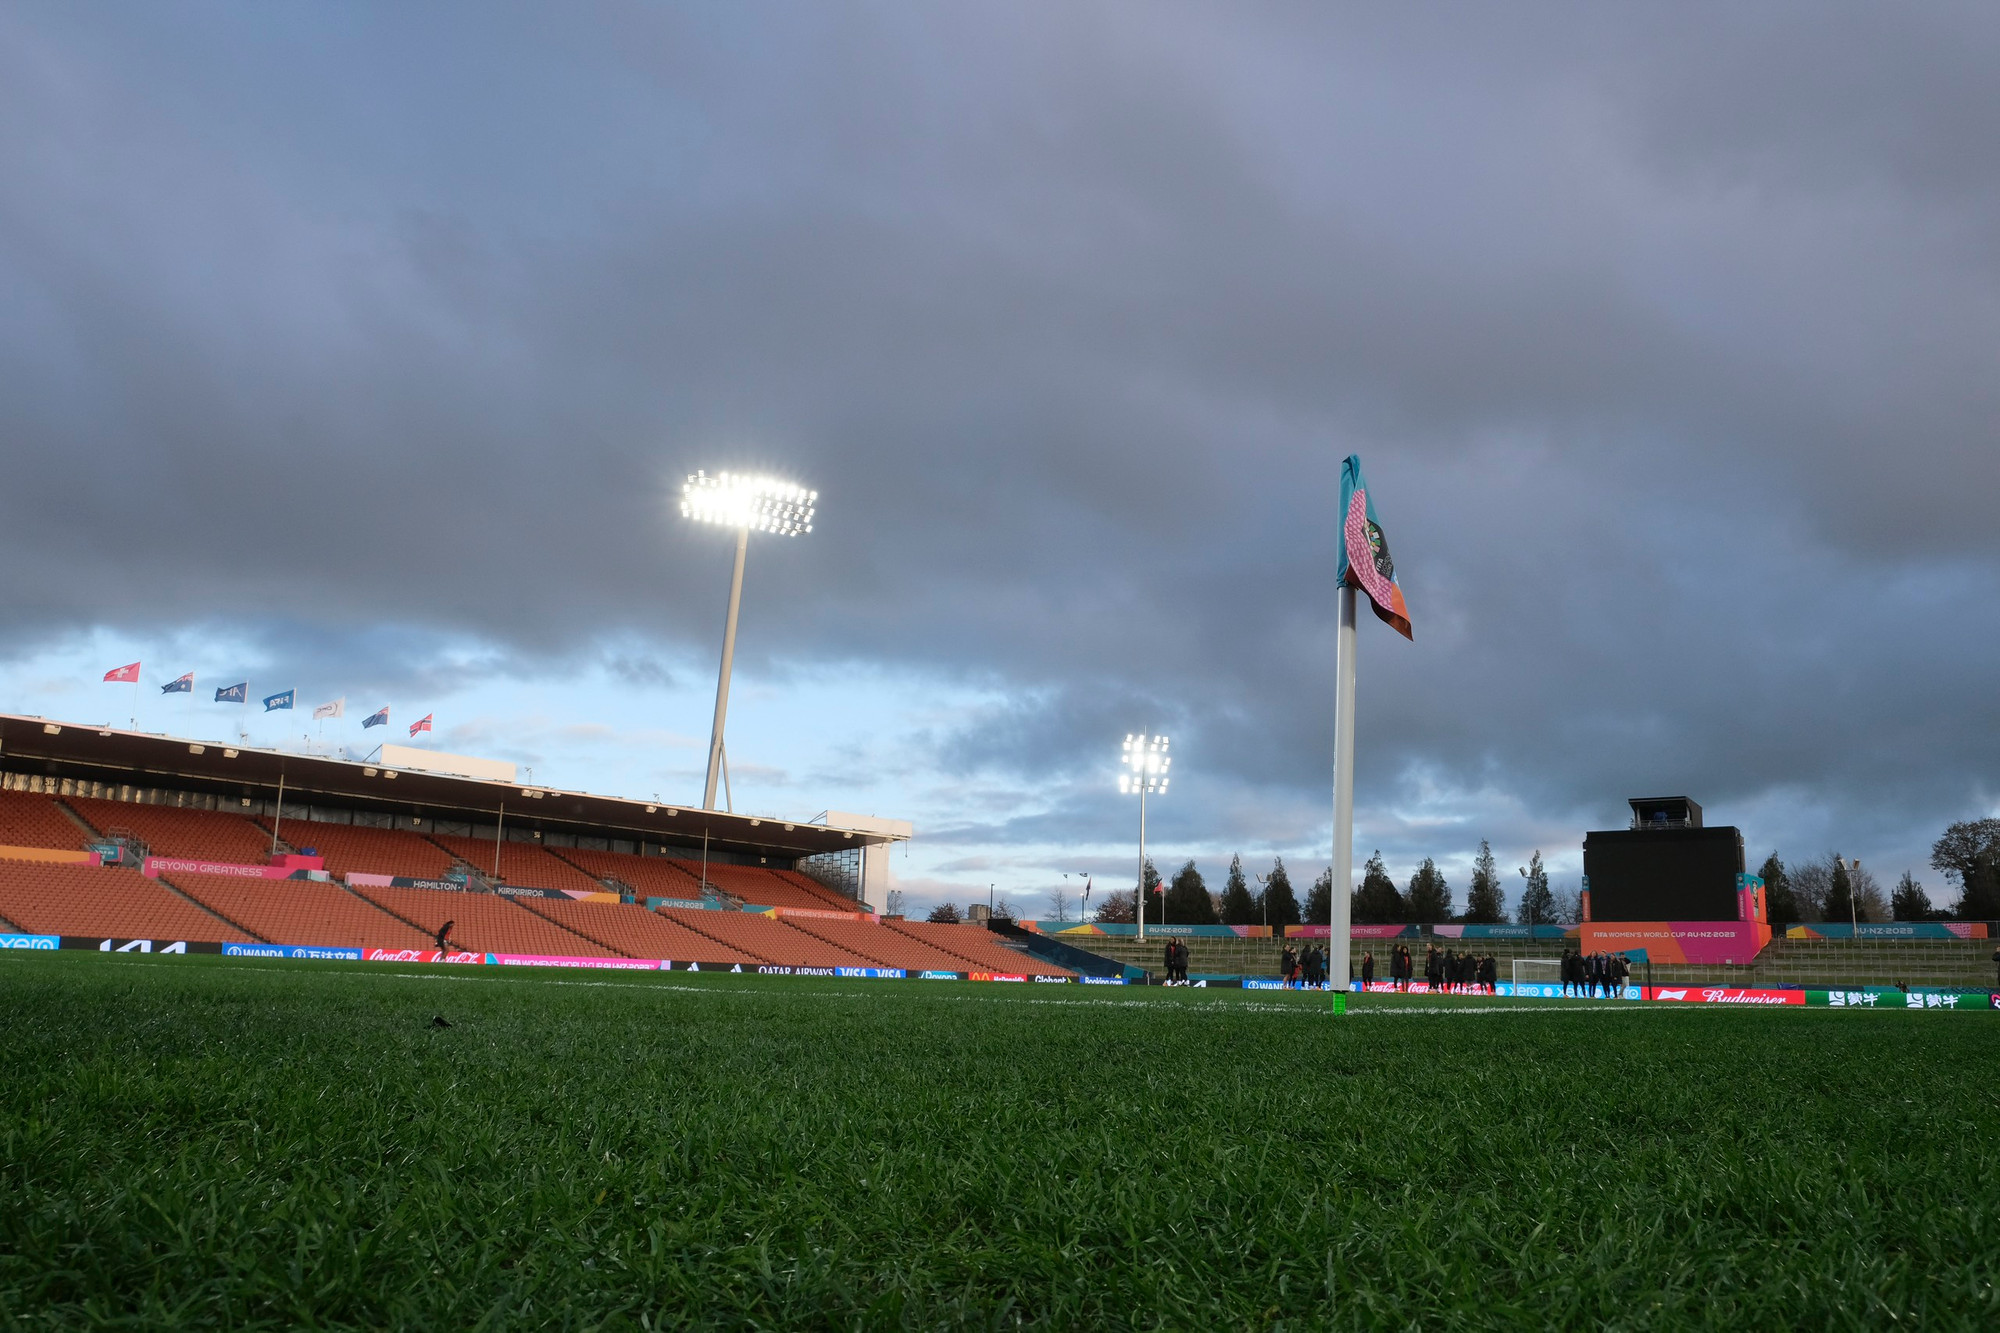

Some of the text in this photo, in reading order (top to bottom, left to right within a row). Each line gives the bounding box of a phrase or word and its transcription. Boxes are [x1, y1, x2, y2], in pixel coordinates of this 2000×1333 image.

[151, 860, 262, 877] BEYOND GREATNESS
[413, 880, 457, 891] HAMILTON
[498, 887, 544, 898] KIRIKIRIROA
[1702, 990, 1787, 1003] Budweiser
